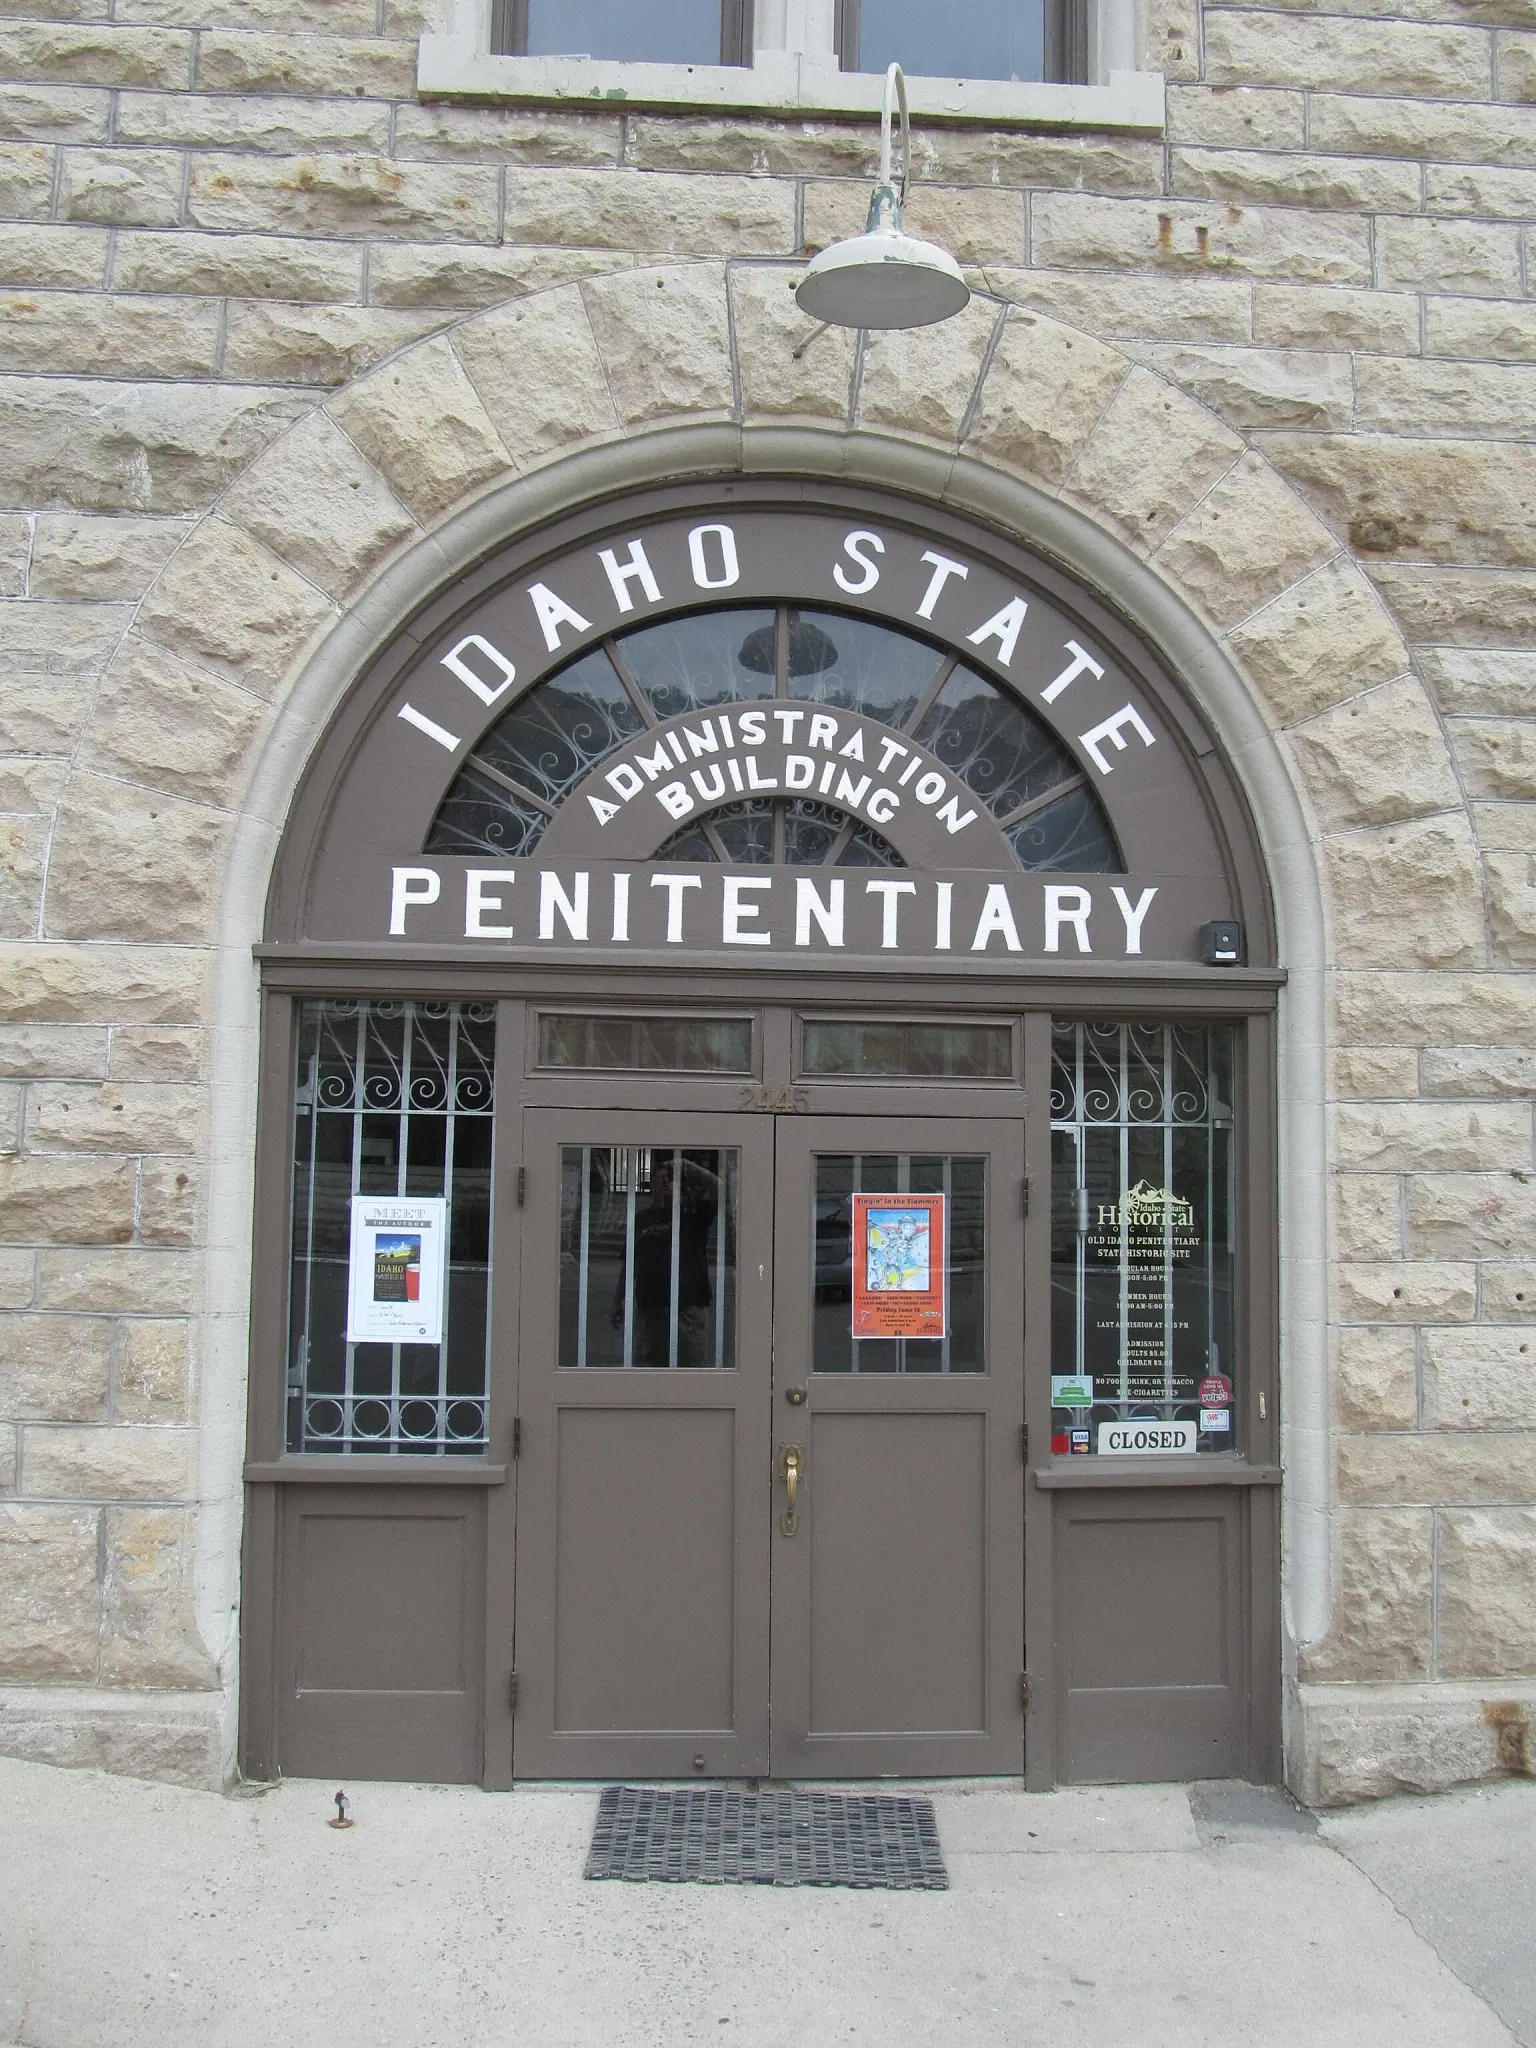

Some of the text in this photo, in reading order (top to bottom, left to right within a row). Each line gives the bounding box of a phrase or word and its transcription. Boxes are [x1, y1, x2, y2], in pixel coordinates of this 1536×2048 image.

[398, 524, 1157, 776] IDAHO STATE
[586, 710, 979, 835] ADMINISTRATION
[657, 756, 901, 825] BUILDING
[390, 867, 1160, 954] PENITENTIARY
[739, 1086, 810, 1113] 2445
[372, 1207, 426, 1219] MEET
[1097, 1205, 1195, 1226] Historical
[1140, 1203, 1186, 1212] Idaho State
[1088, 1236, 1105, 1245] OLD
[1136, 1237, 1200, 1246] PENITENTIARY
[1097, 1248, 1191, 1258] STATE HISTORIC SITE
[377, 1264, 404, 1273] IDAHO
[1108, 1431, 1187, 1450] CLOSED
